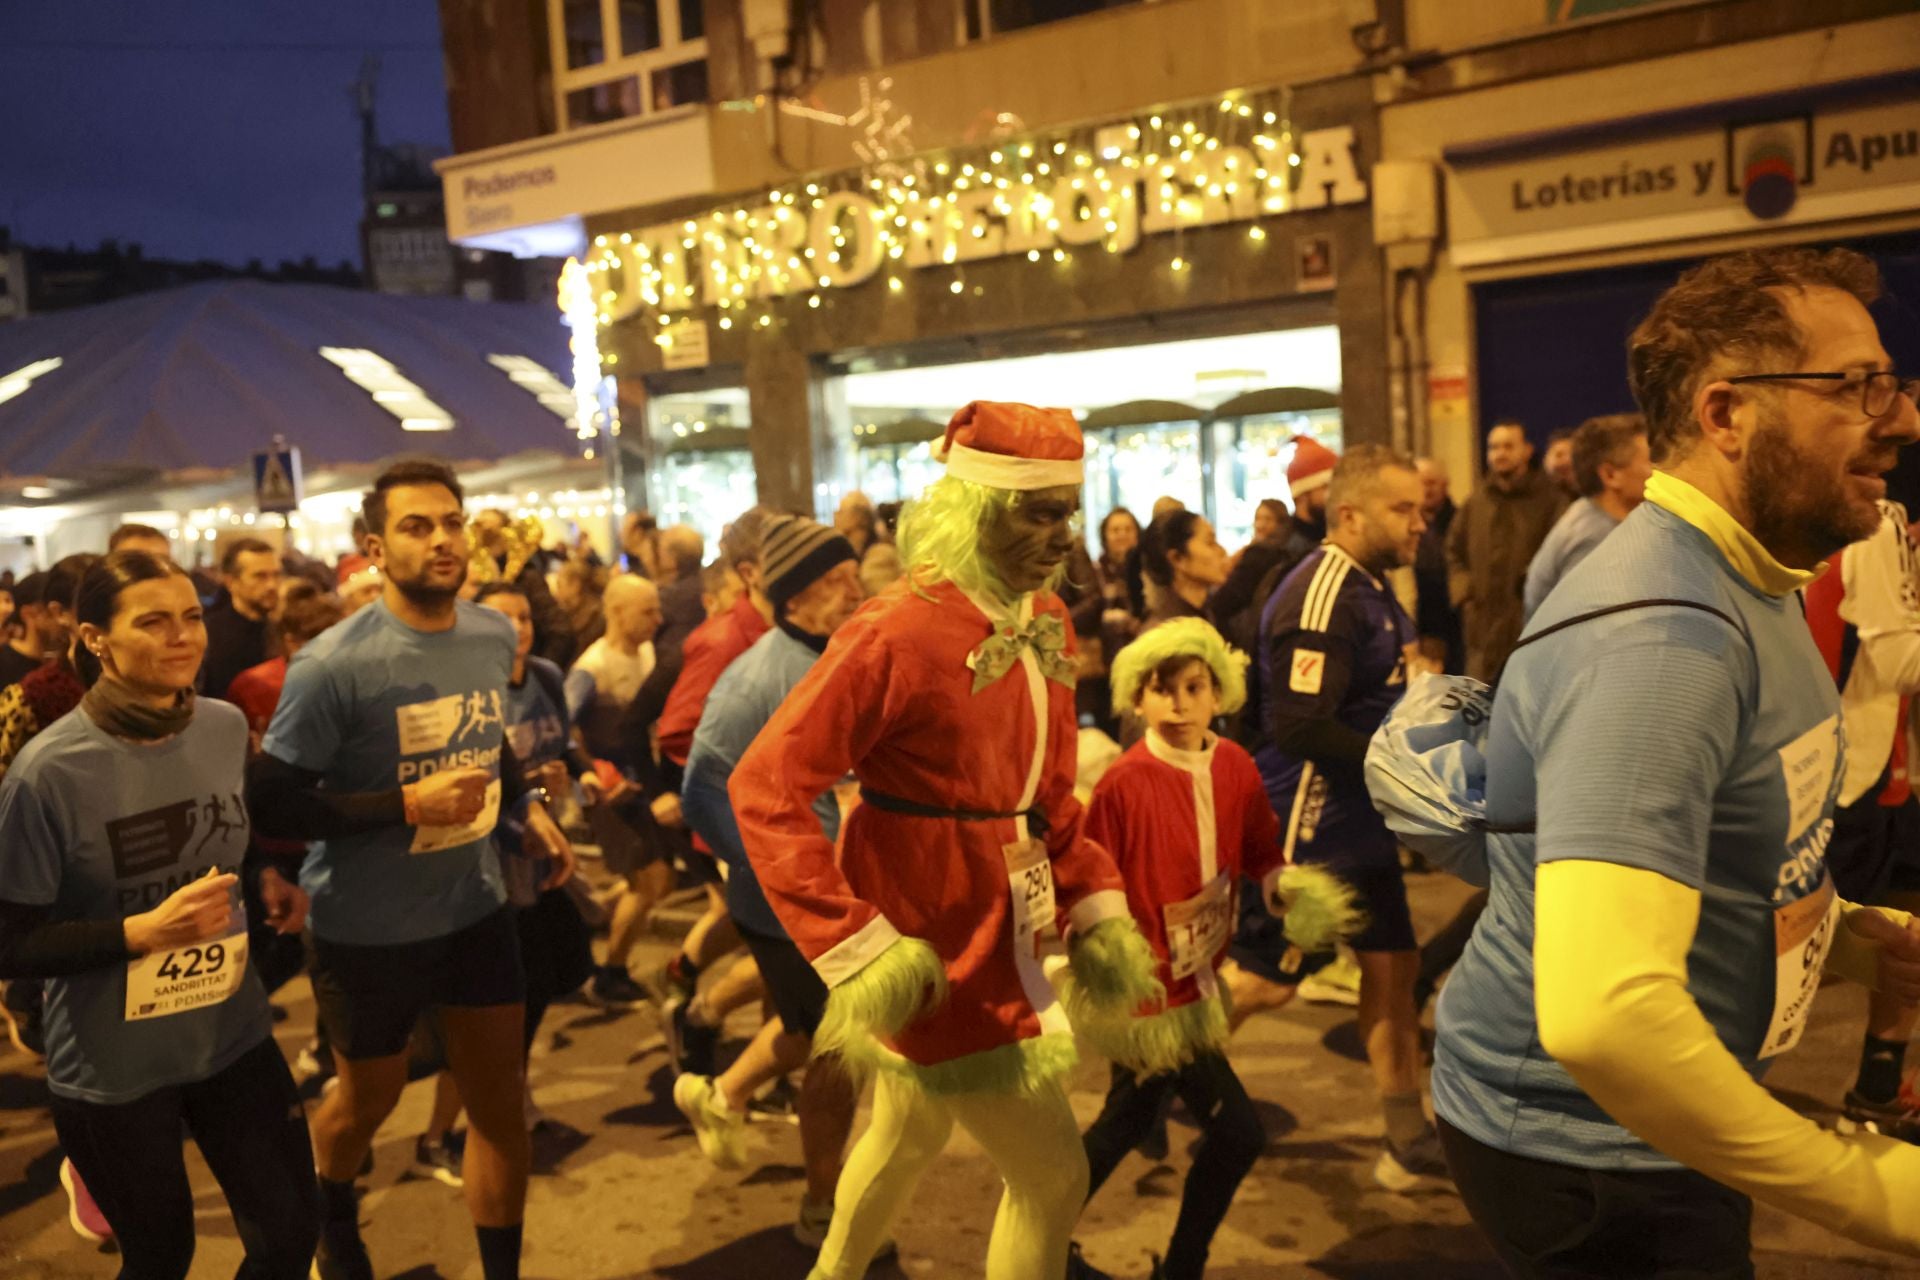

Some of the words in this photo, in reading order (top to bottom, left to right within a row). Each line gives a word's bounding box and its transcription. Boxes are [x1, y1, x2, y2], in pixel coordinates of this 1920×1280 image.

[1690, 158, 1716, 195] y
[1025, 863, 1049, 902] 290
[156, 943, 225, 981] 429
